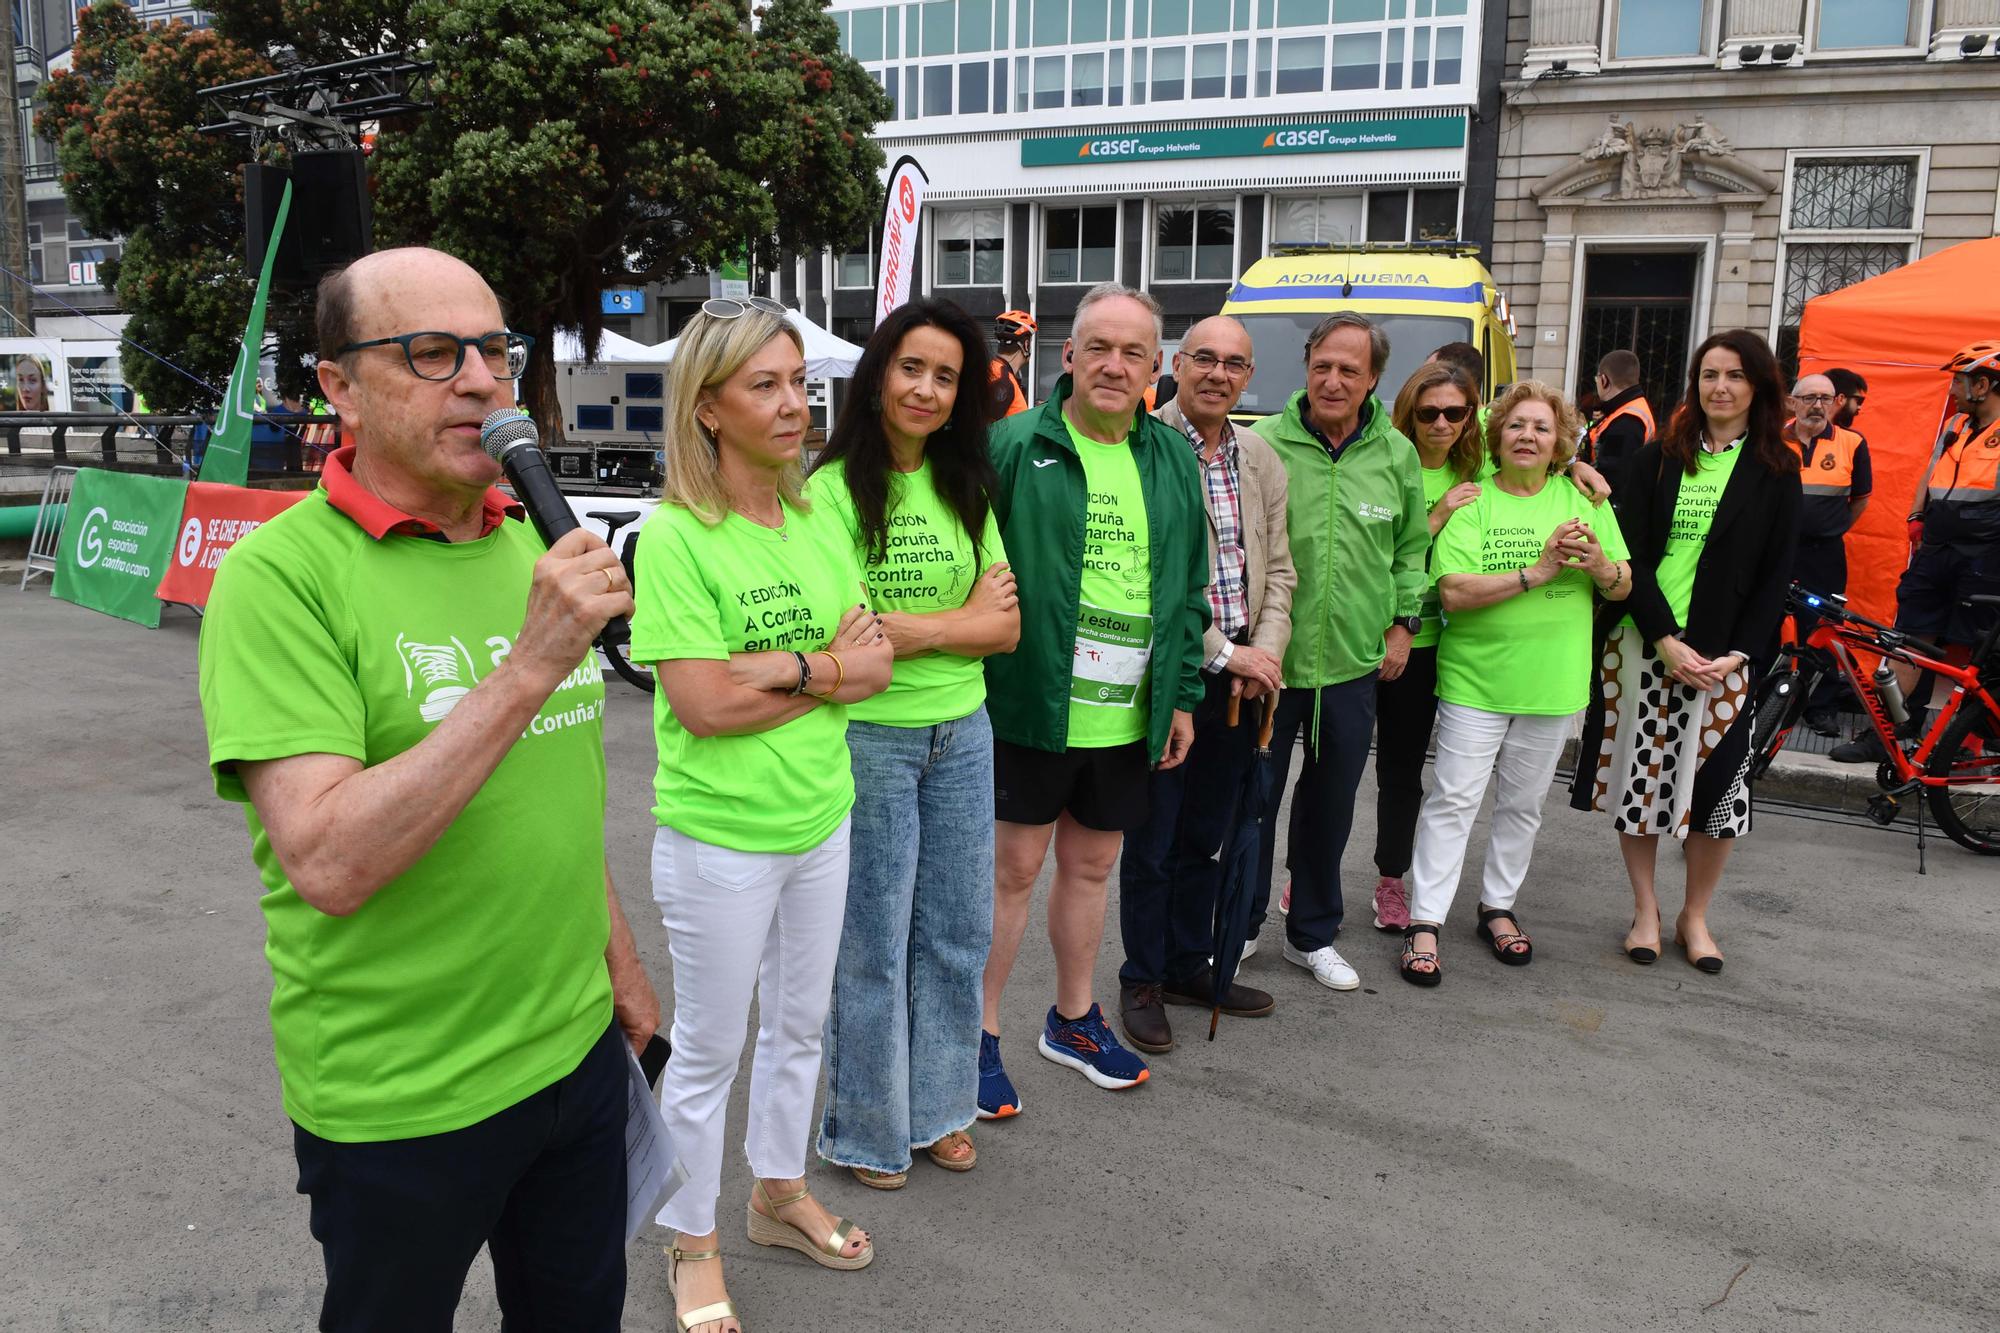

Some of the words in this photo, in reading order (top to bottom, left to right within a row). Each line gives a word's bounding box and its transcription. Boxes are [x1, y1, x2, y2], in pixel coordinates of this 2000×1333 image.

[1276, 129, 1330, 147] caser
[1328, 136, 1358, 146] Grupo
[1359, 133, 1397, 143] Helvetia
[1091, 139, 1140, 156] caser
[1139, 145, 1165, 155] Grupo
[1166, 142, 1201, 152] Helvetia
[112, 519, 149, 537] asociación
[206, 519, 221, 541] SE
[219, 519, 240, 542] CHE
[107, 538, 139, 554] española
[1482, 541, 1491, 551] A
[1494, 538, 1542, 549] Coruña
[893, 547, 955, 565] marcha
[1482, 553, 1497, 562] en
[101, 556, 126, 572] contra
[125, 564, 131, 573] o
[867, 567, 923, 582] contra
[736, 591, 749, 607] X
[882, 585, 938, 599] cancro
[744, 615, 760, 633] A
[1088, 615, 1131, 633] estou
[744, 637, 771, 651] en
[1099, 632, 1121, 641] contra
